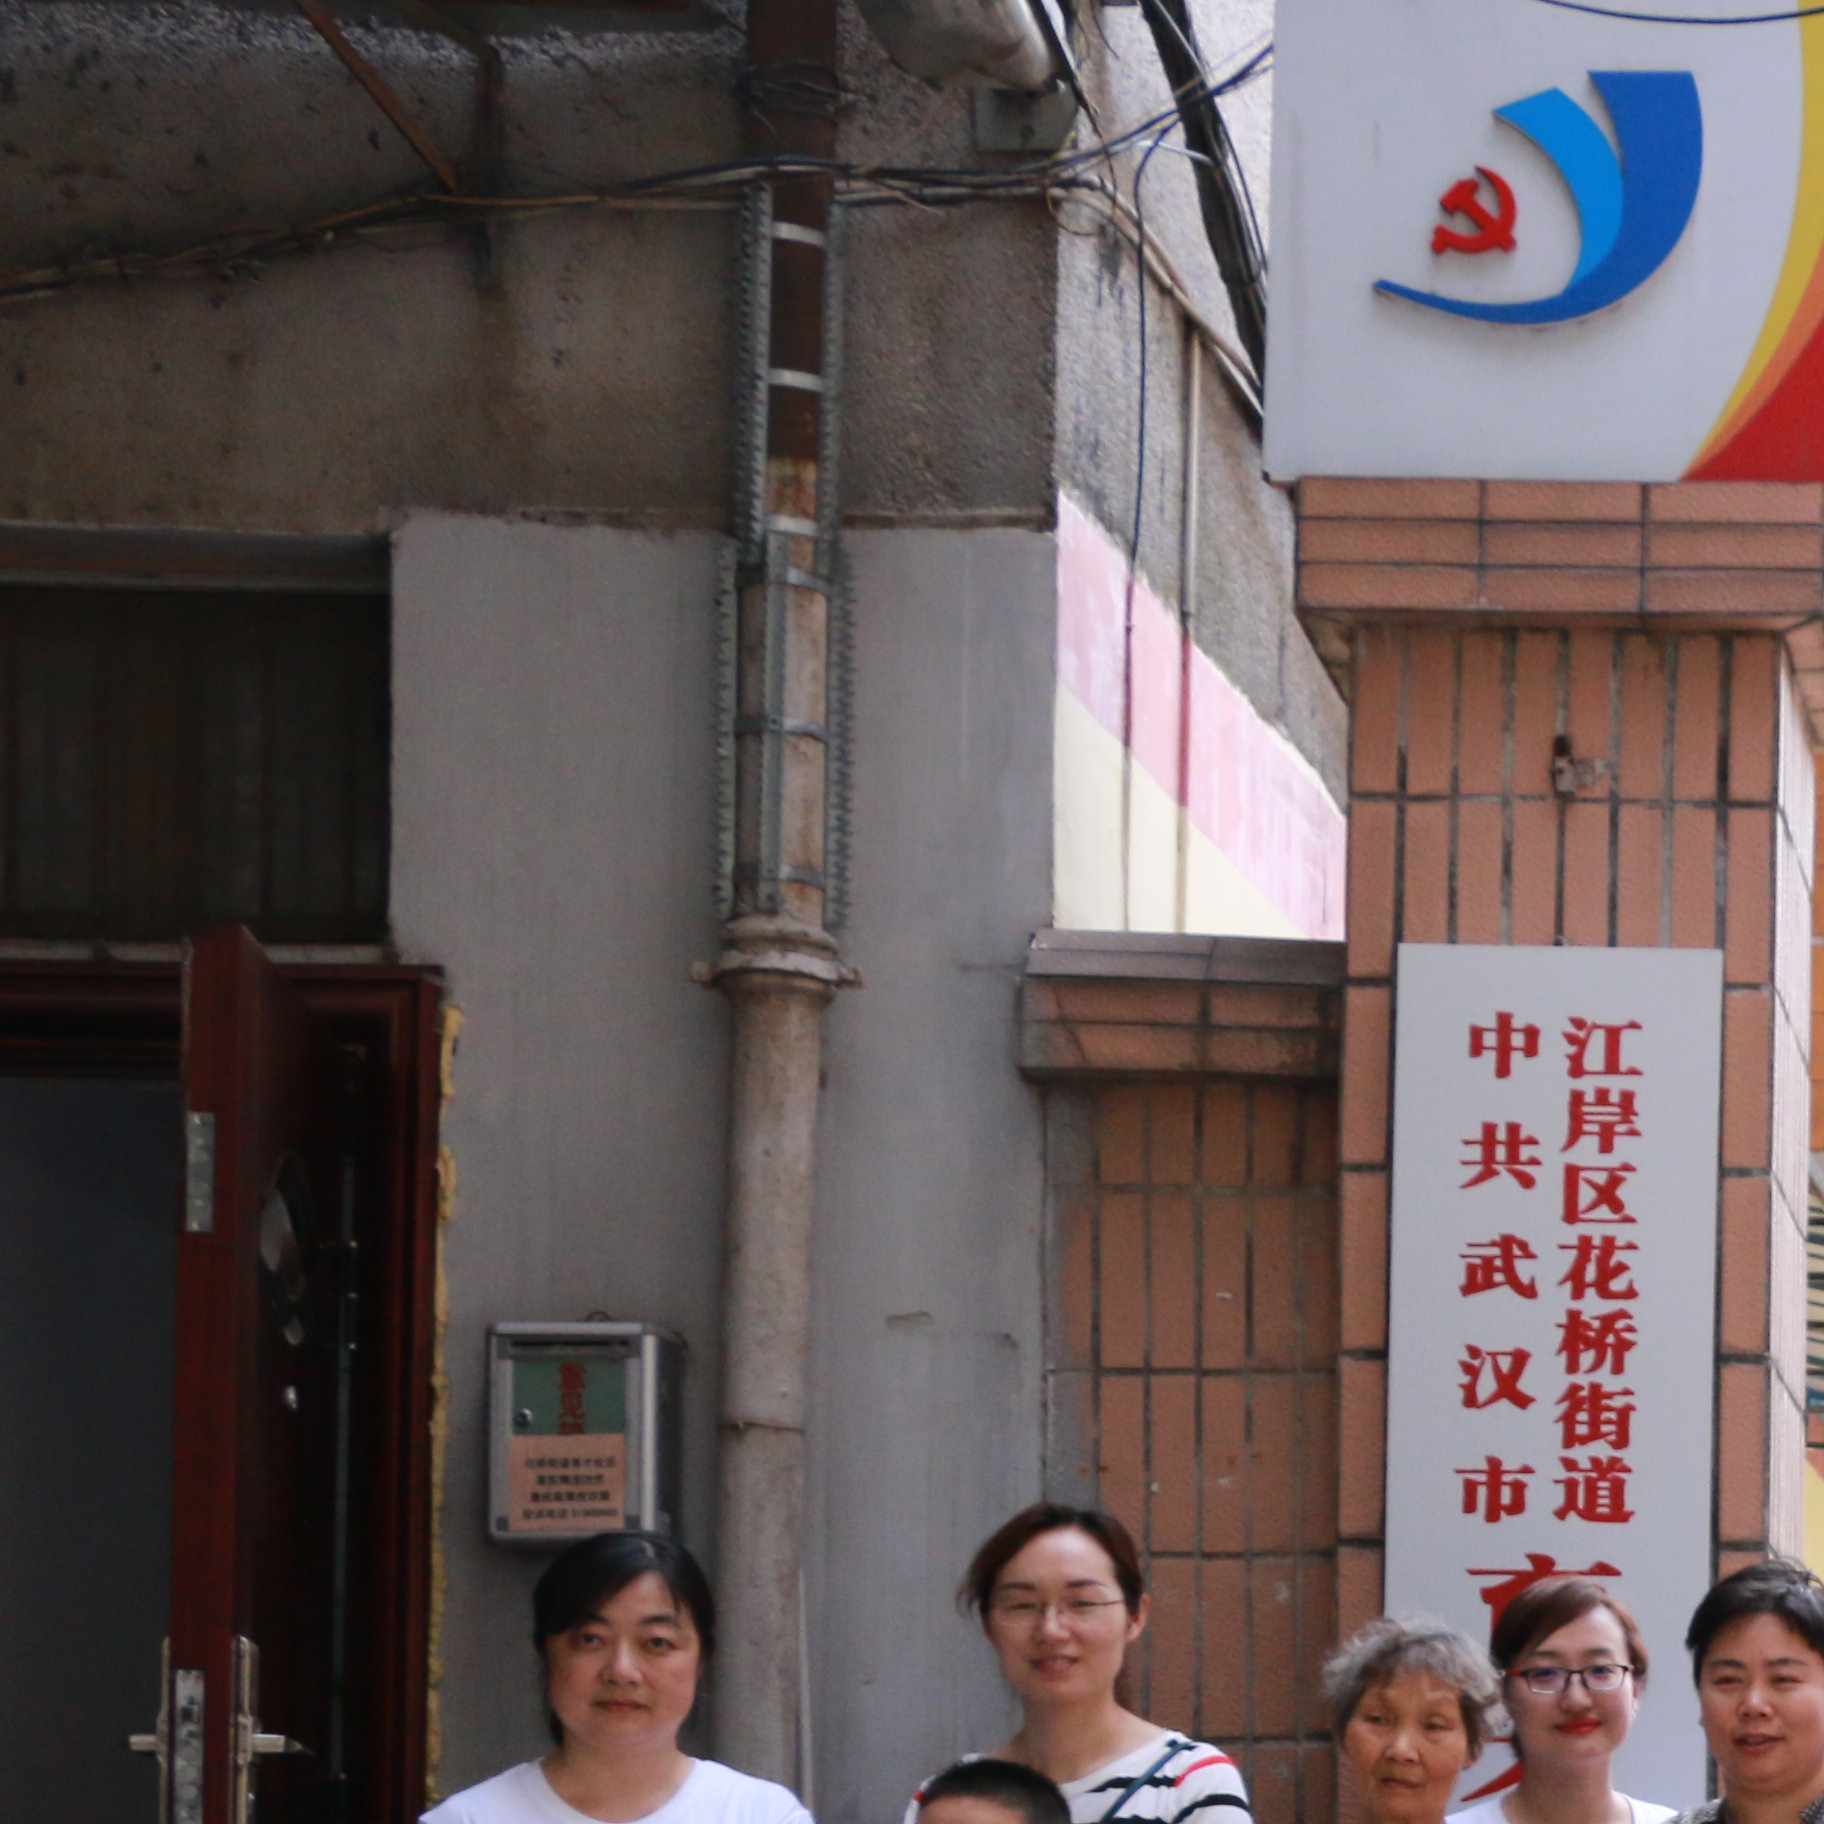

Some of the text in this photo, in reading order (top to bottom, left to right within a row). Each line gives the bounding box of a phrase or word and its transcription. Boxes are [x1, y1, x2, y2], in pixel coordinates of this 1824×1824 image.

[1454, 1012, 1542, 1523] 中共武汉市
[1553, 1016, 1644, 1524] 江岸区花桥街道
